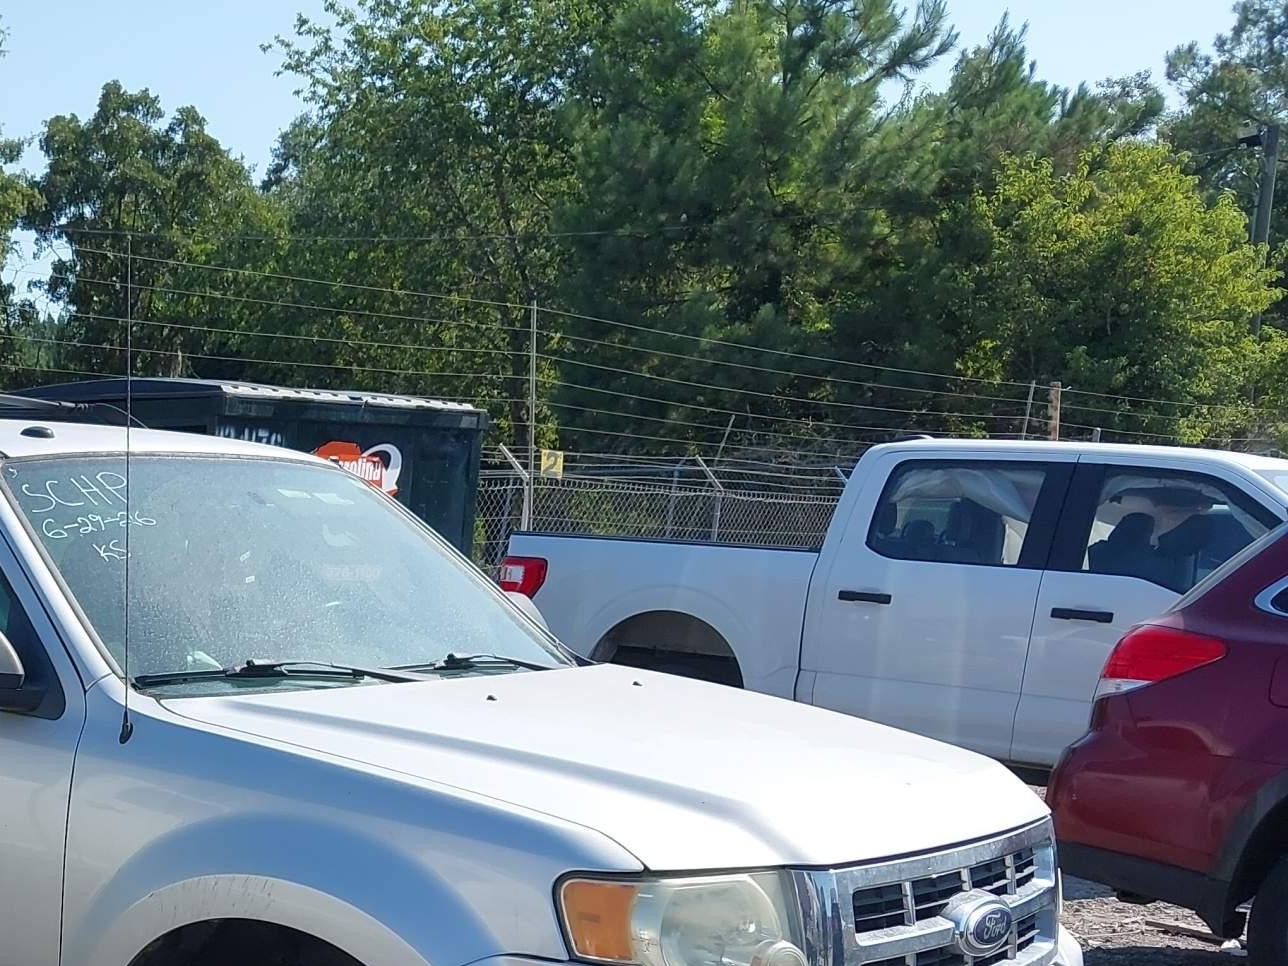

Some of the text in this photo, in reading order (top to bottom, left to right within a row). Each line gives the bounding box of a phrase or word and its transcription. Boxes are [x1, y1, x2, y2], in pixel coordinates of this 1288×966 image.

[542, 451, 561, 478] 2
[21, 471, 128, 513] SCHP
[983, 911, 1008, 939] Ford
